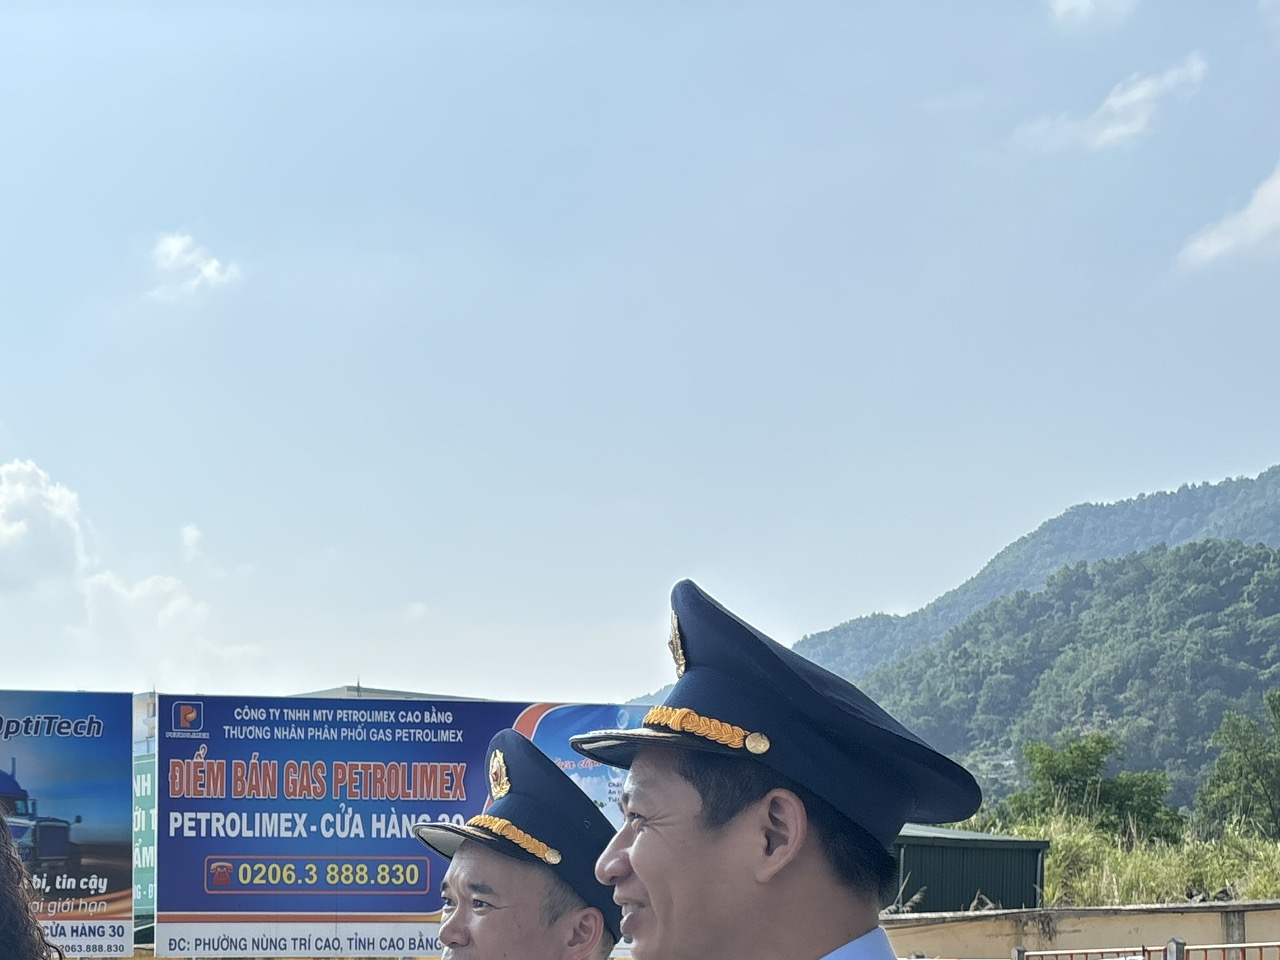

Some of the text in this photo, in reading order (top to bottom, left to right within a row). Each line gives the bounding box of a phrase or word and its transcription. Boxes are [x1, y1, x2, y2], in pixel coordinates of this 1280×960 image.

[234, 705, 453, 724] CÔNG TY TNHH MTV PETROLIMEX CAO BẰNG
[223, 723, 464, 743] THƯƠNG NHÂN PHÂN PHỐI GAS PETROLIMEX
[168, 744, 467, 801] ĐIỂM BÁN GAS PETROLIMEX
[134, 773, 151, 797] NH
[169, 812, 308, 838] PETROLIMEX
[320, 802, 365, 839] CỬA
[55, 874, 76, 890] tin
[80, 874, 108, 895] cậy
[237, 863, 420, 886] 0206.3 888.830
[48, 897, 76, 916] giới
[79, 897, 107, 916] hạn
[44, 921, 125, 938] CỬA HÀNG 30
[60, 944, 124, 952] 2063.888.830
[168, 931, 442, 954] ĐC: PHƯỜNG NÙNG TRÍ CAO, TỈNH CAO BẰNG
